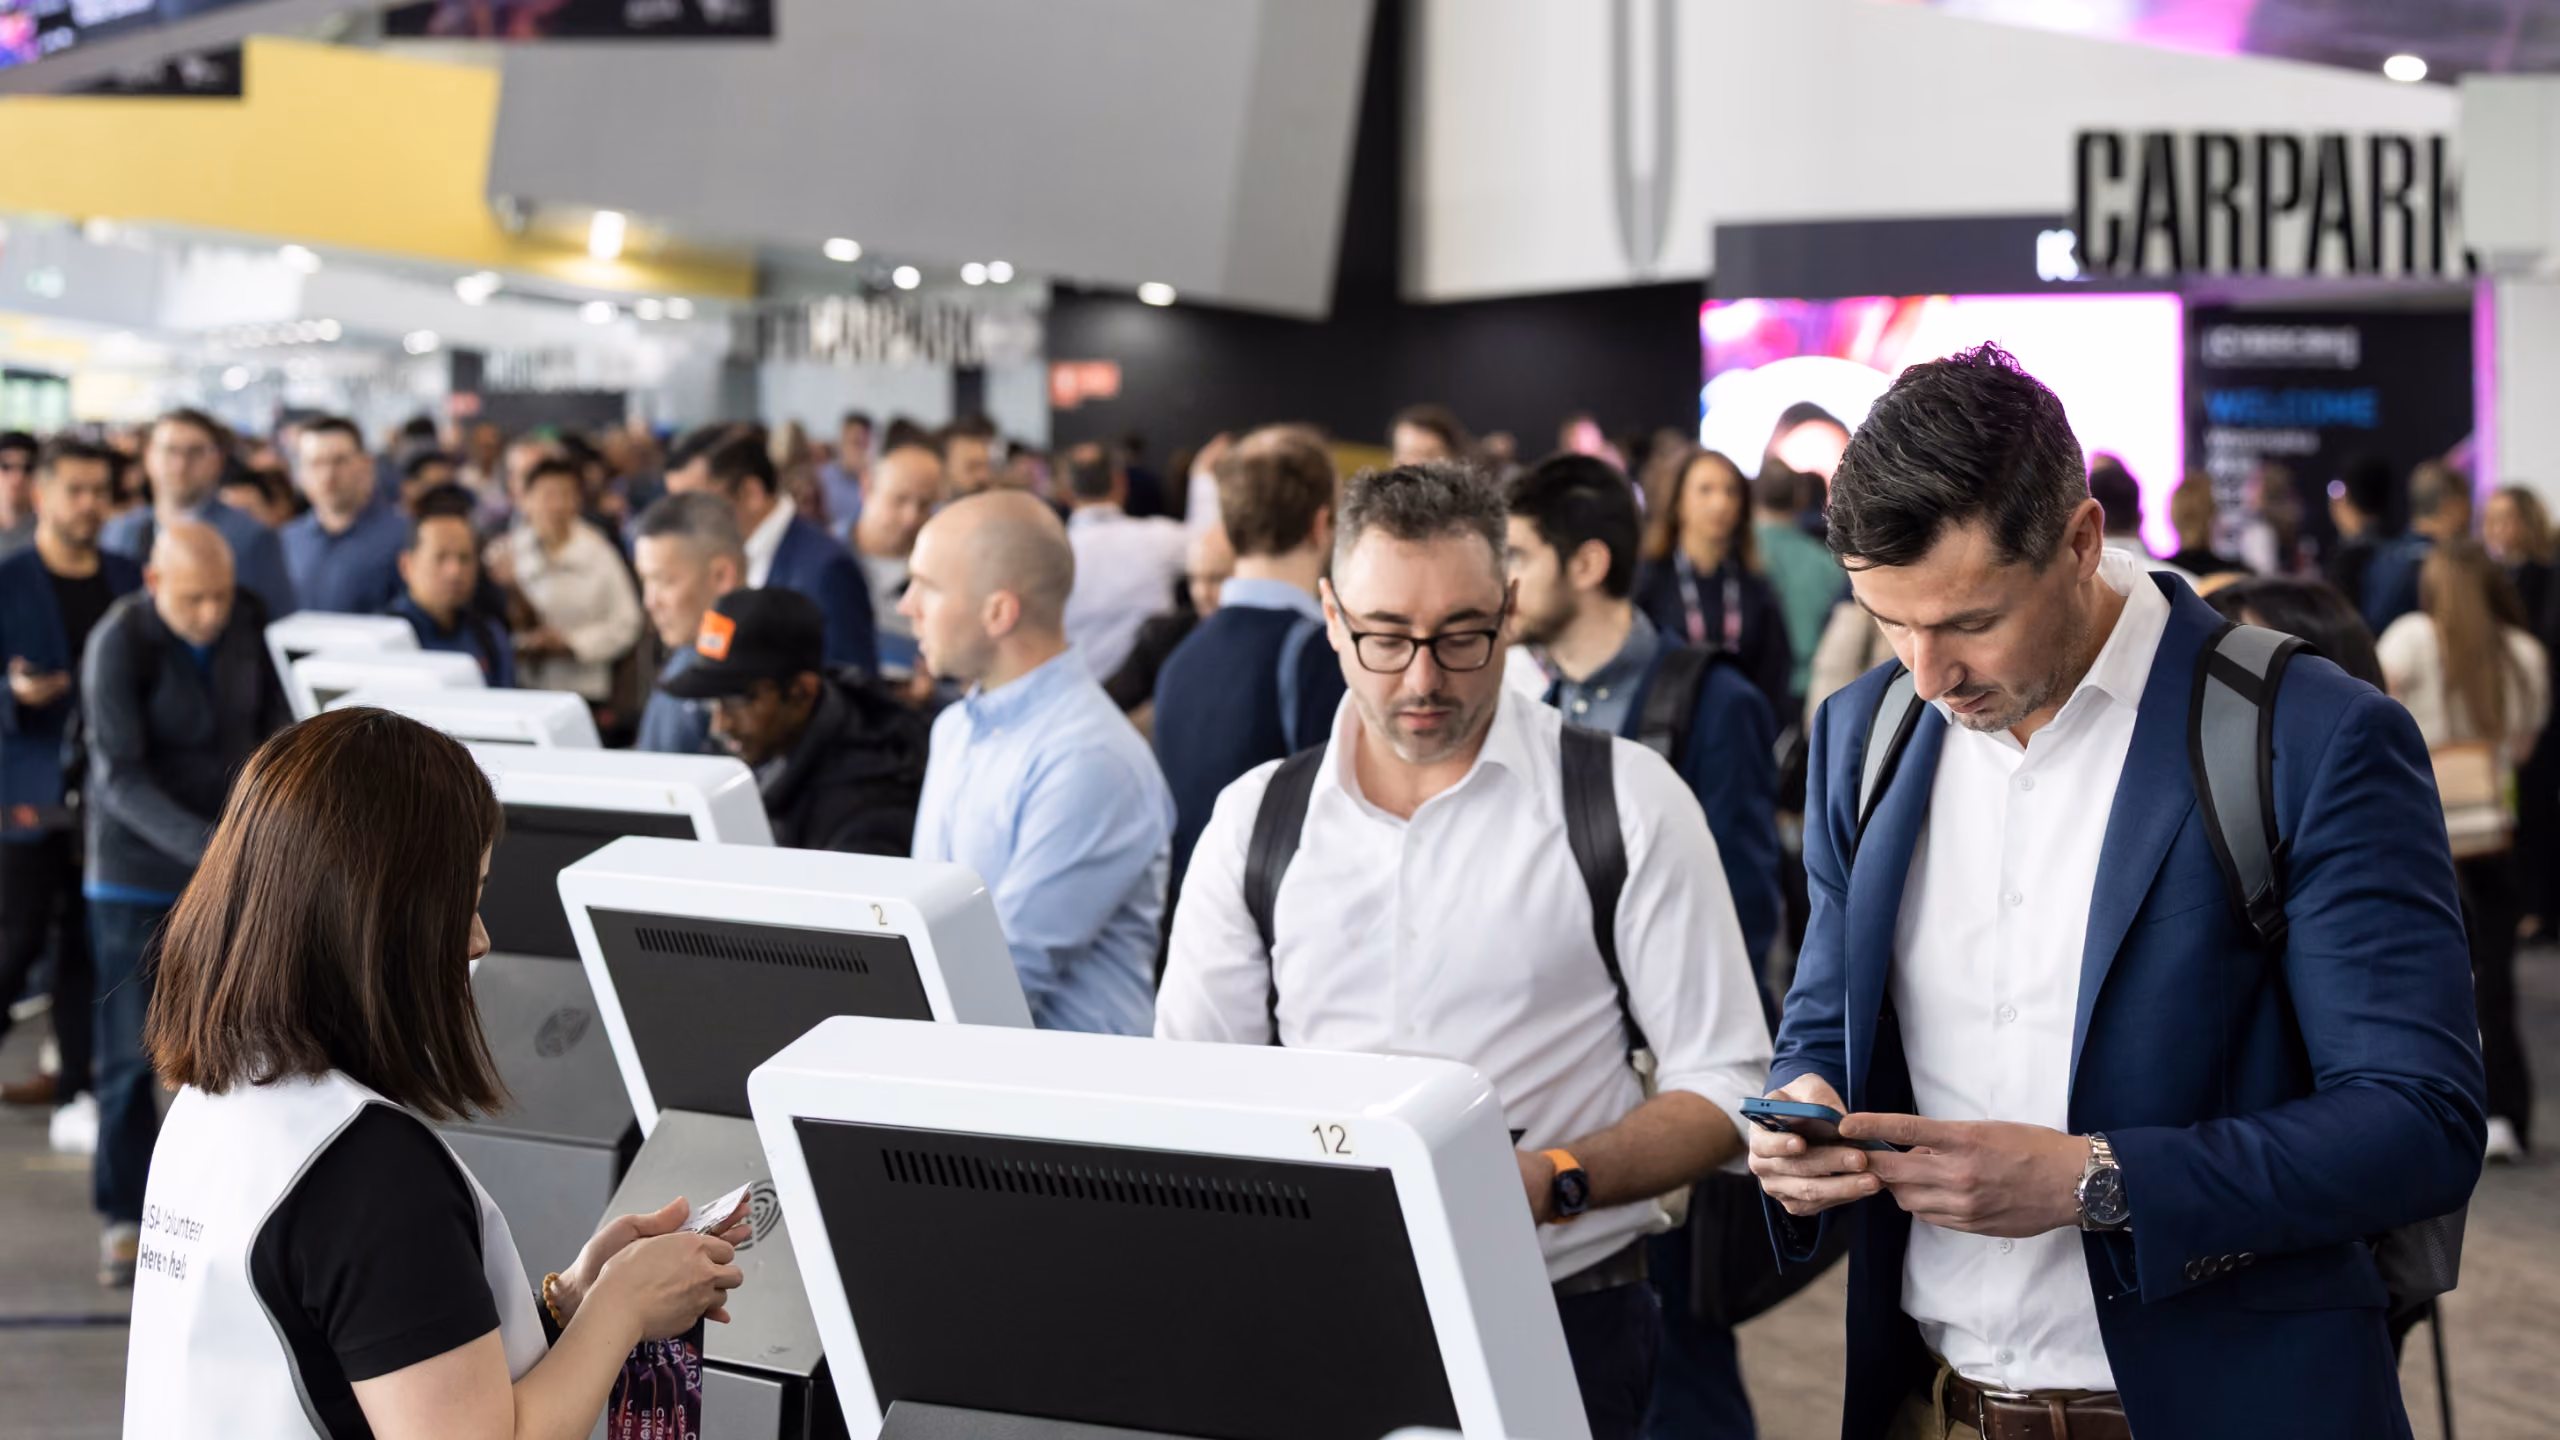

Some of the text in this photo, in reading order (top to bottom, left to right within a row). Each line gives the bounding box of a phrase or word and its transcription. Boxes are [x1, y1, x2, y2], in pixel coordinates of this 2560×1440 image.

[869, 903, 888, 926] 2
[1312, 1124, 1352, 1155] 12
[685, 1351, 698, 1391] AISA
